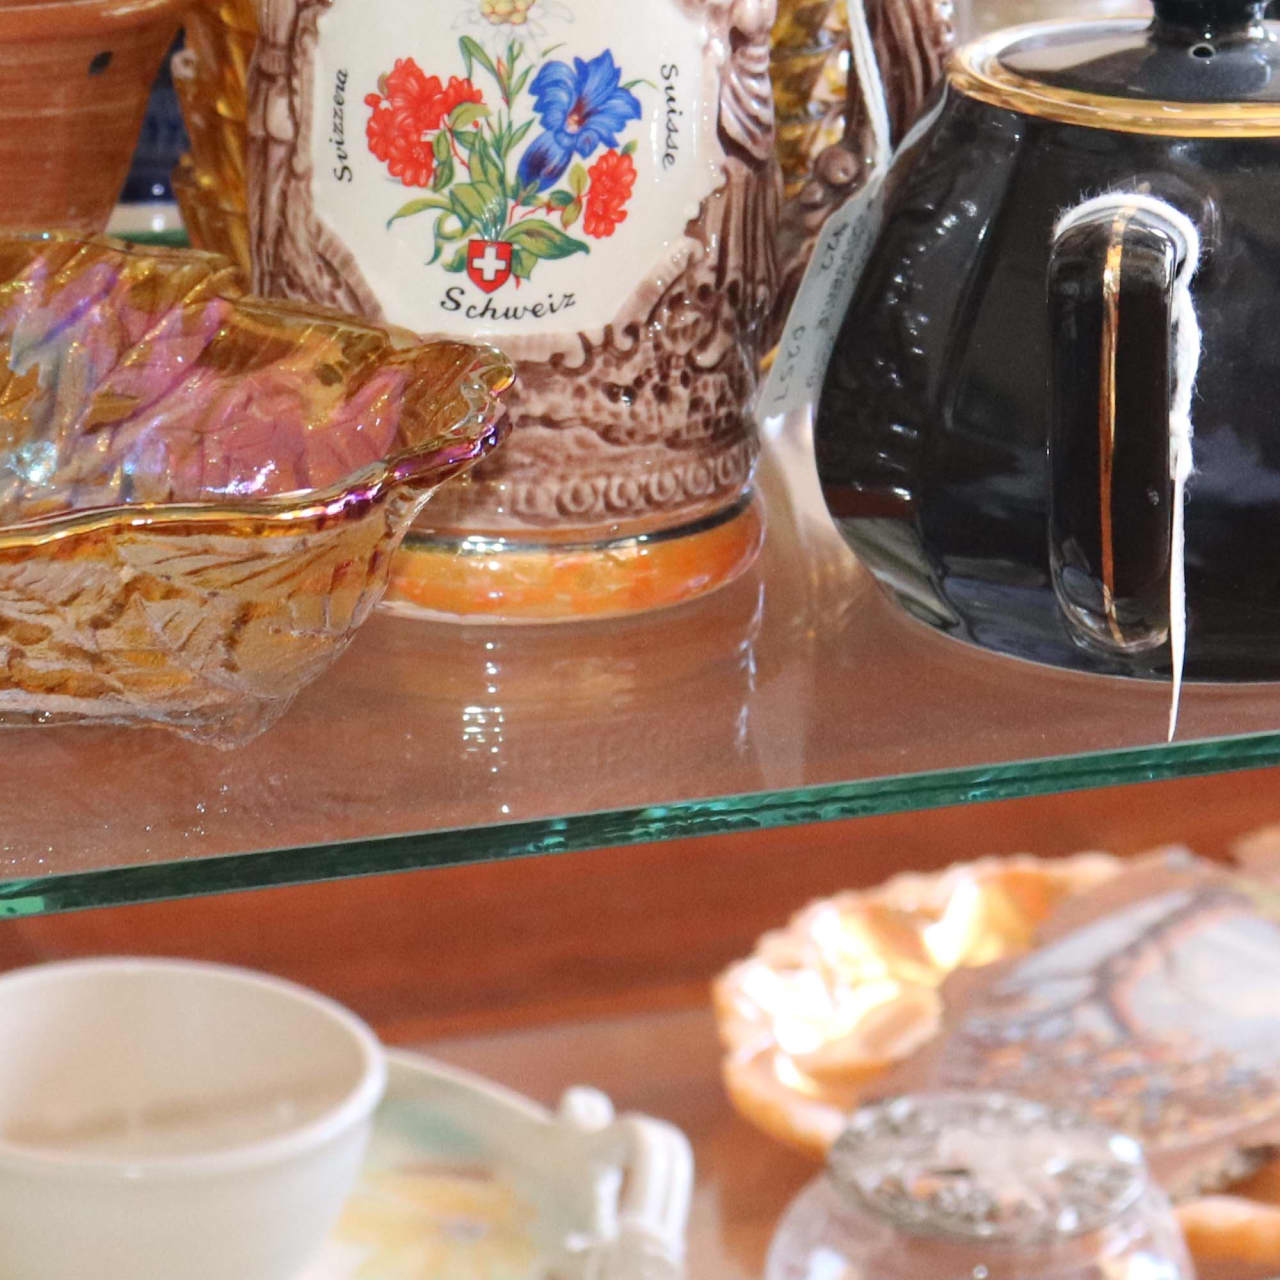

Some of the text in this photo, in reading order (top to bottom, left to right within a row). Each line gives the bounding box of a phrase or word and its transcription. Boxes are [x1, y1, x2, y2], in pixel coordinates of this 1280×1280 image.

[329, 68, 352, 183] Svizzera
[660, 63, 684, 171] Suisse
[440, 287, 576, 321] Schweiz
